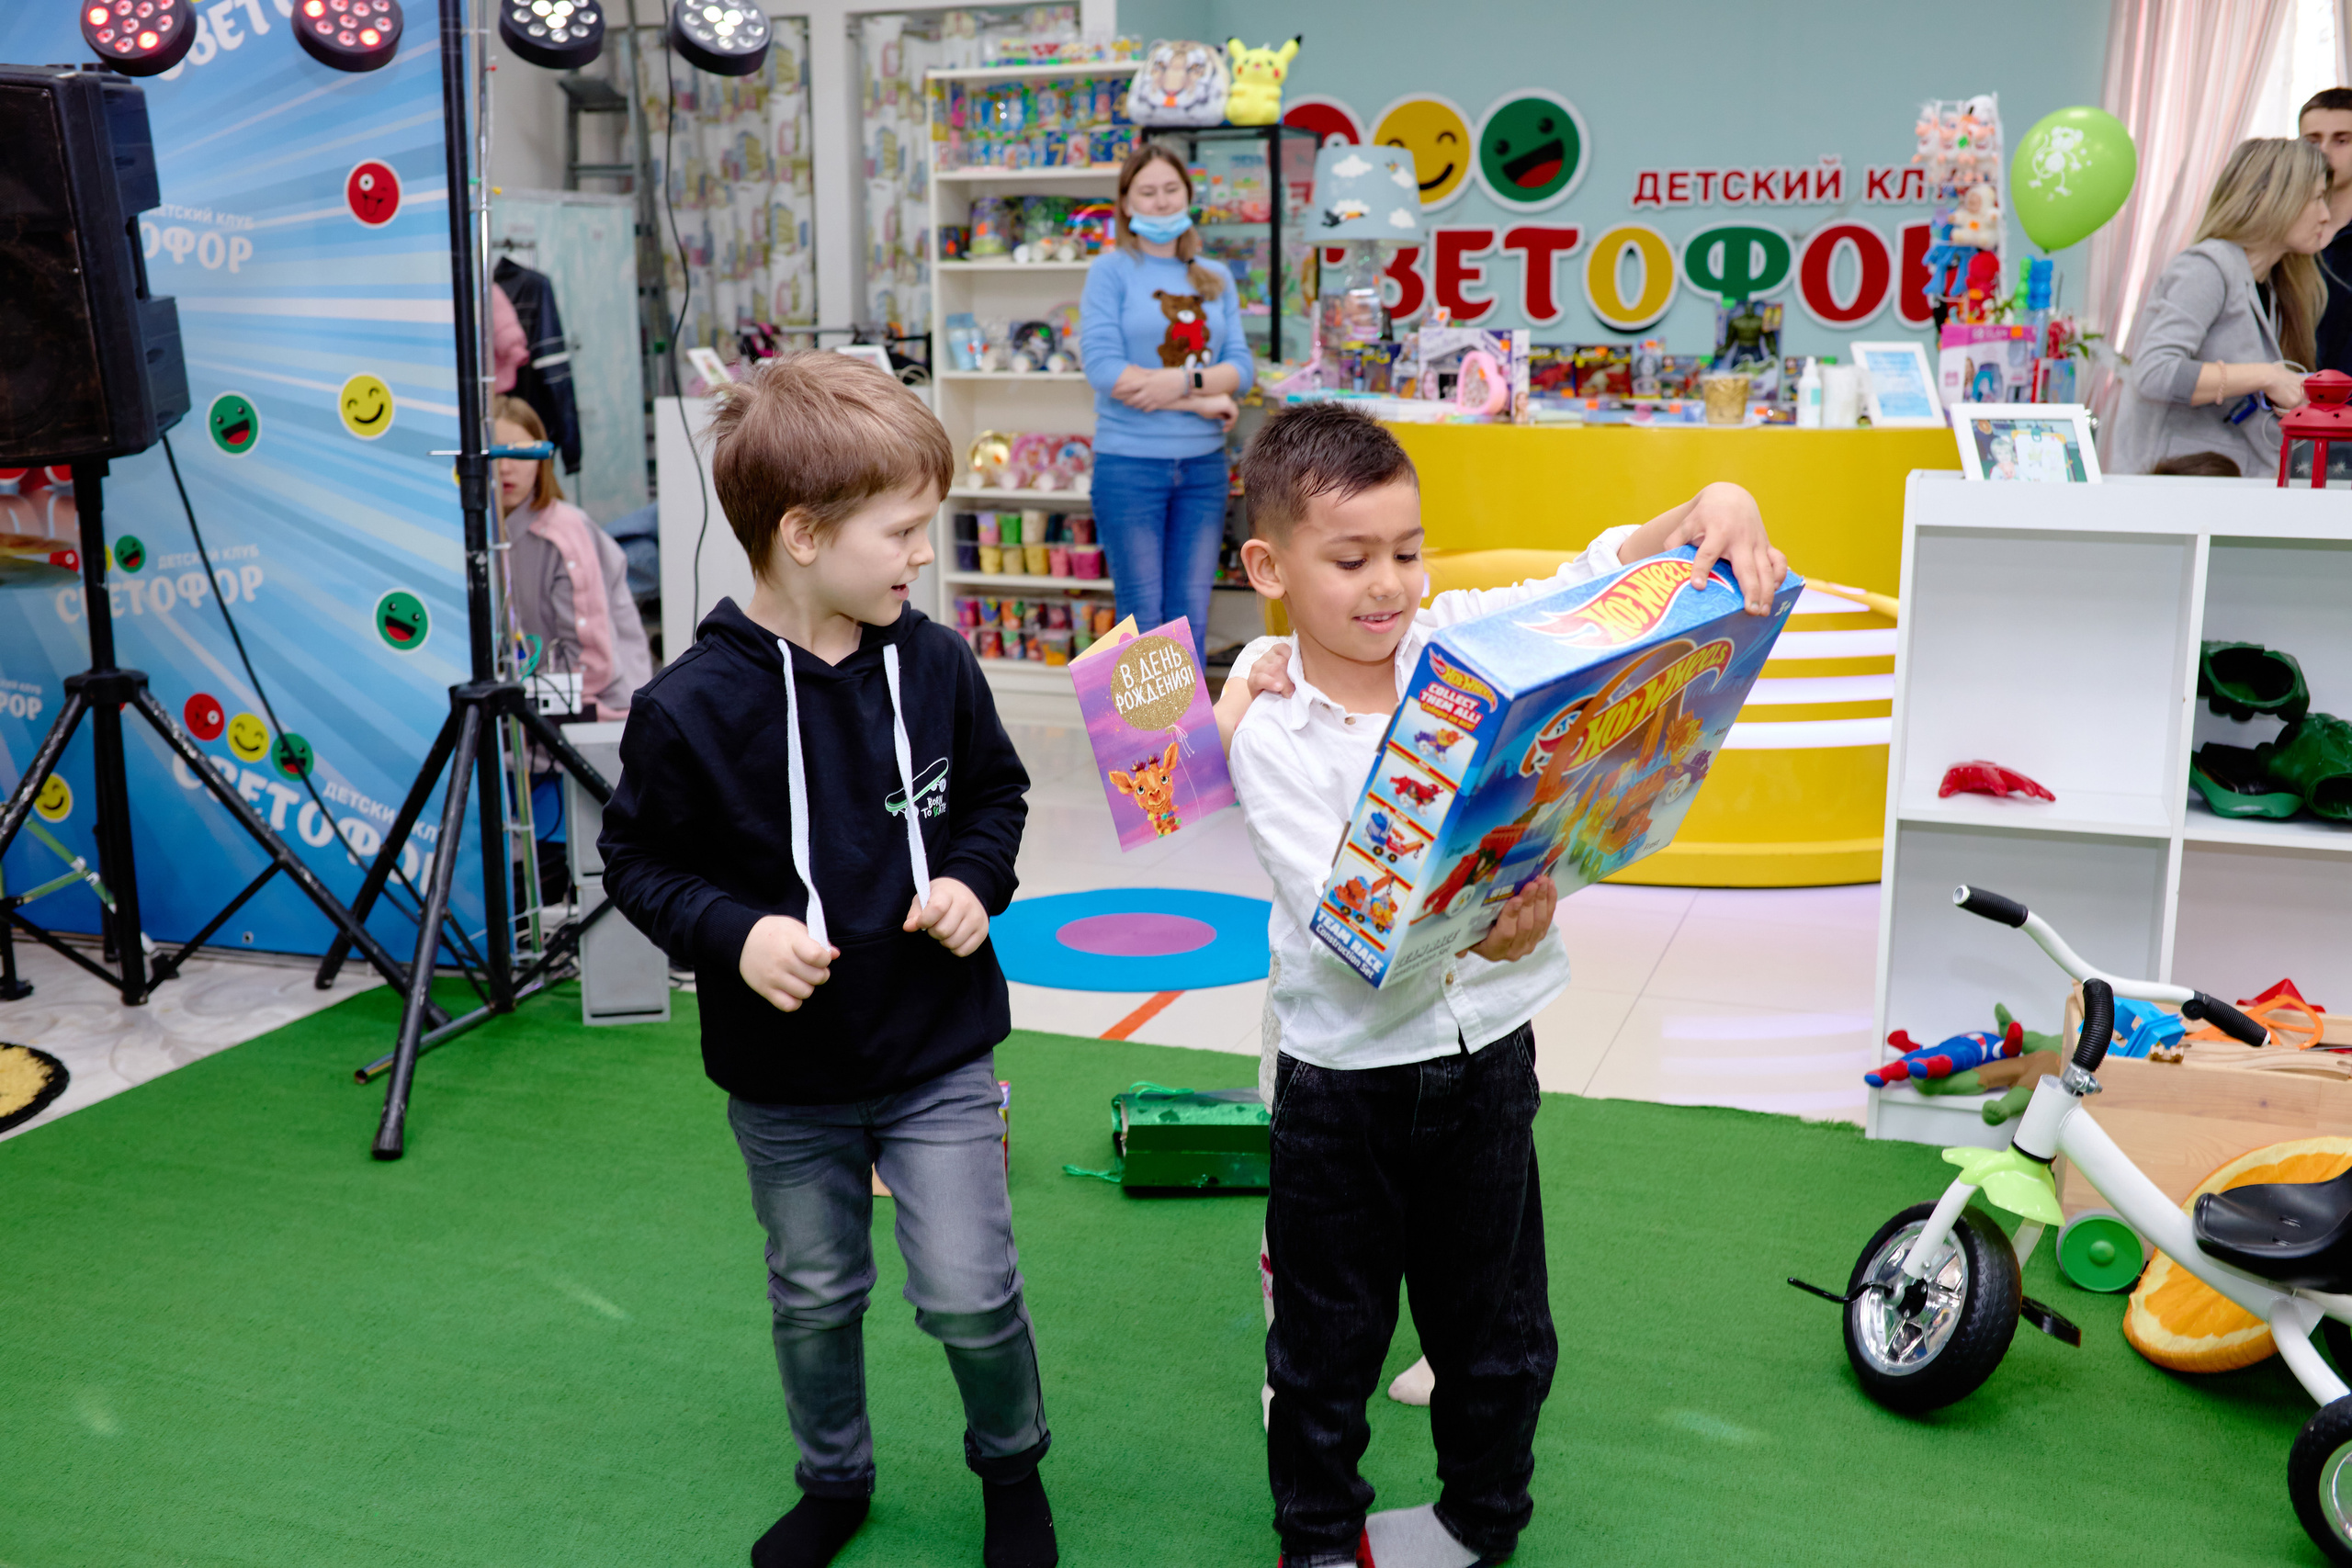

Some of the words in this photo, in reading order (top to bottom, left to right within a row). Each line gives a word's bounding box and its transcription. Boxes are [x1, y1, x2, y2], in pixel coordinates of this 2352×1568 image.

[158, 0, 292, 81] ВЕТ
[1632, 157, 1840, 206] ДЕТСКИЙ
[216, 212, 254, 231] КЛУБ
[158, 548, 220, 570] ДЕТСКЙ
[222, 544, 260, 563] КЛУБ
[55, 565, 264, 624] СЕТОФОР
[1120, 663, 1135, 689] В
[1139, 644, 1182, 684] ДЕНЬ
[1420, 690, 1454, 713] THEM
[1427, 682, 1480, 711] COLLECT
[323, 780, 396, 825] ДЕТСКИ
[1316, 923, 1362, 969] Construction
[1359, 963, 1375, 980] Set
[1317, 910, 1352, 944] TEAM
[1350, 940, 1385, 974] RACE
